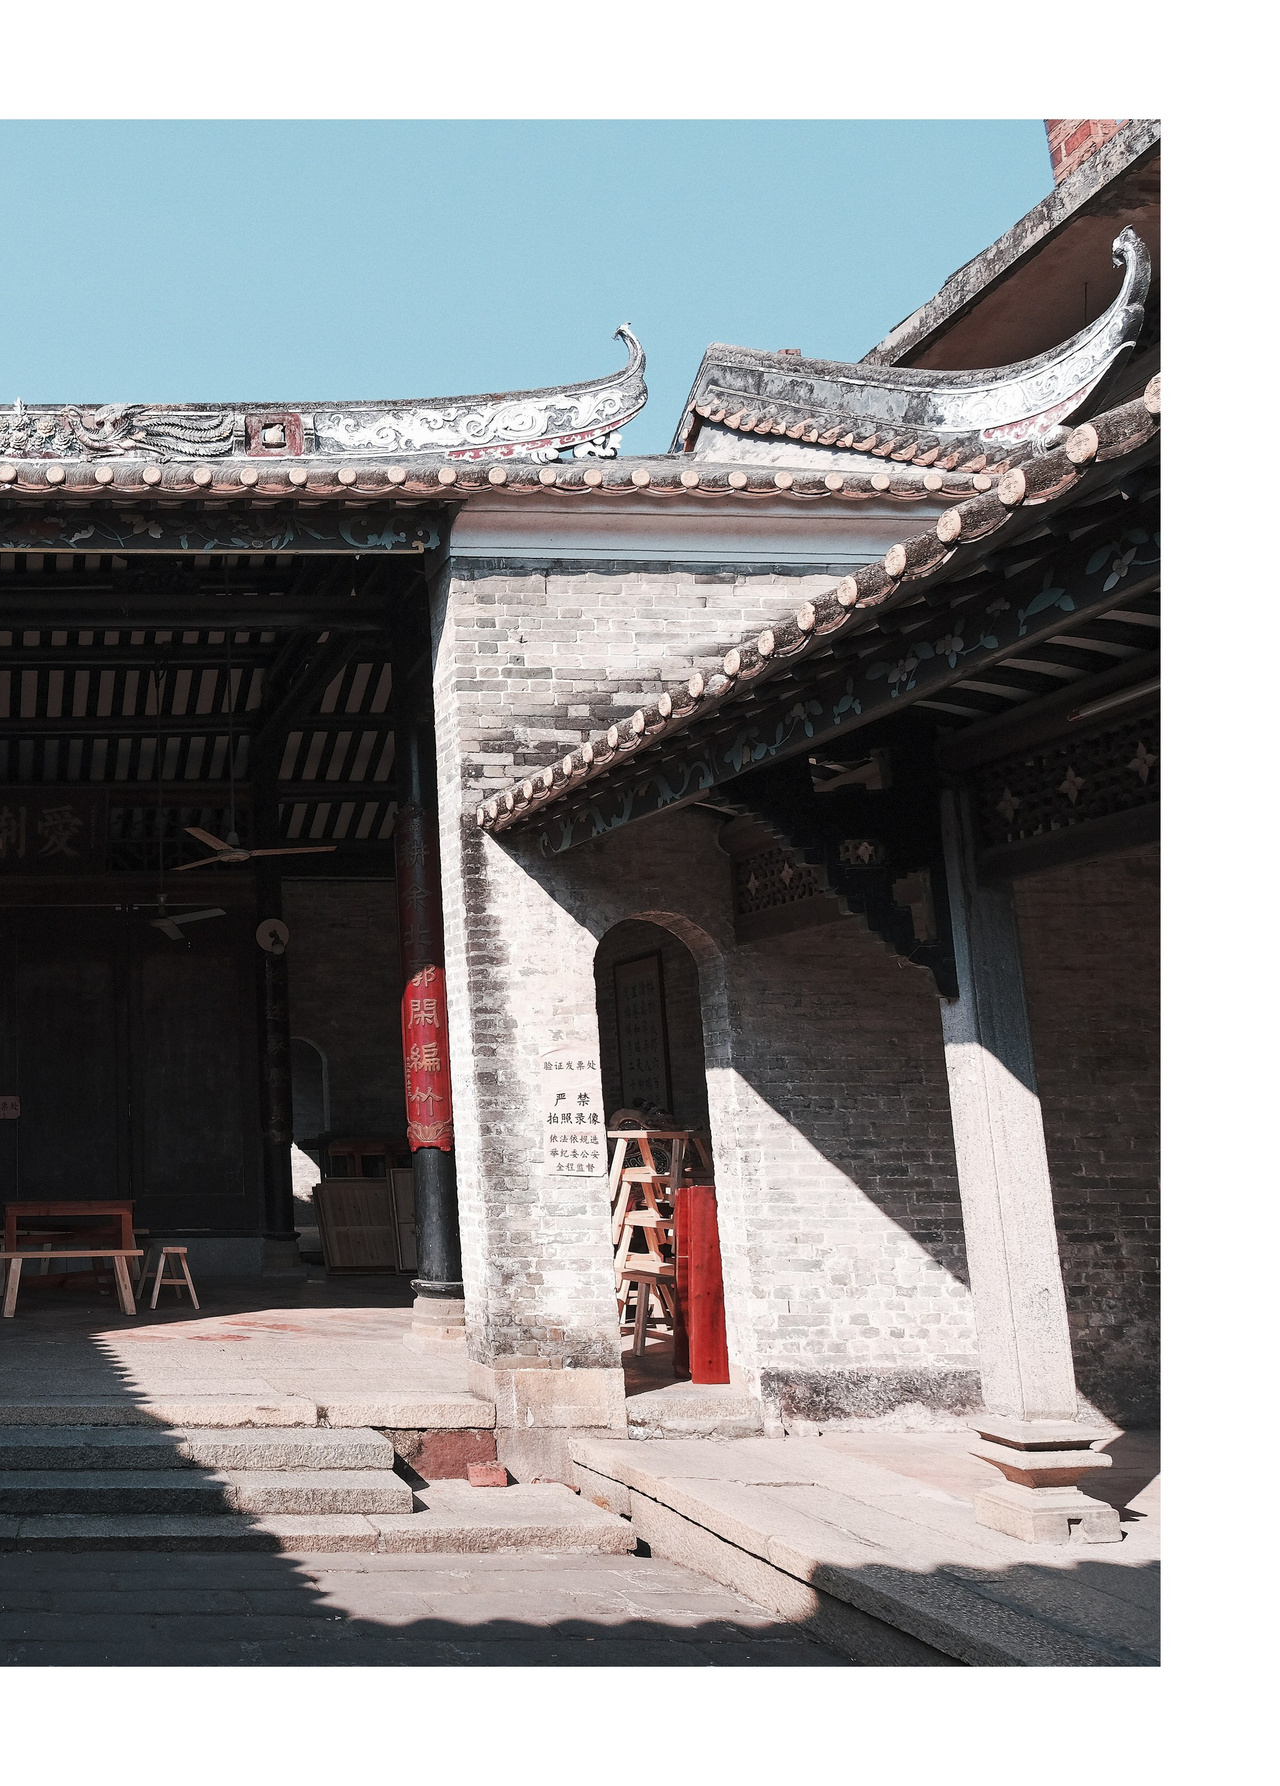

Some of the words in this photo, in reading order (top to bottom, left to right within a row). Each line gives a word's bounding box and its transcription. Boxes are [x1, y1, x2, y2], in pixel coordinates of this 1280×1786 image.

[543, 1060, 597, 1071] 验证发票处
[554, 1092, 590, 1107] 严禁
[547, 1112, 601, 1125] 拍照录像
[549, 1134, 599, 1145] 依法依规选
[549, 1148, 600, 1159] 举纪委公安
[556, 1162, 595, 1173] 全程监督
